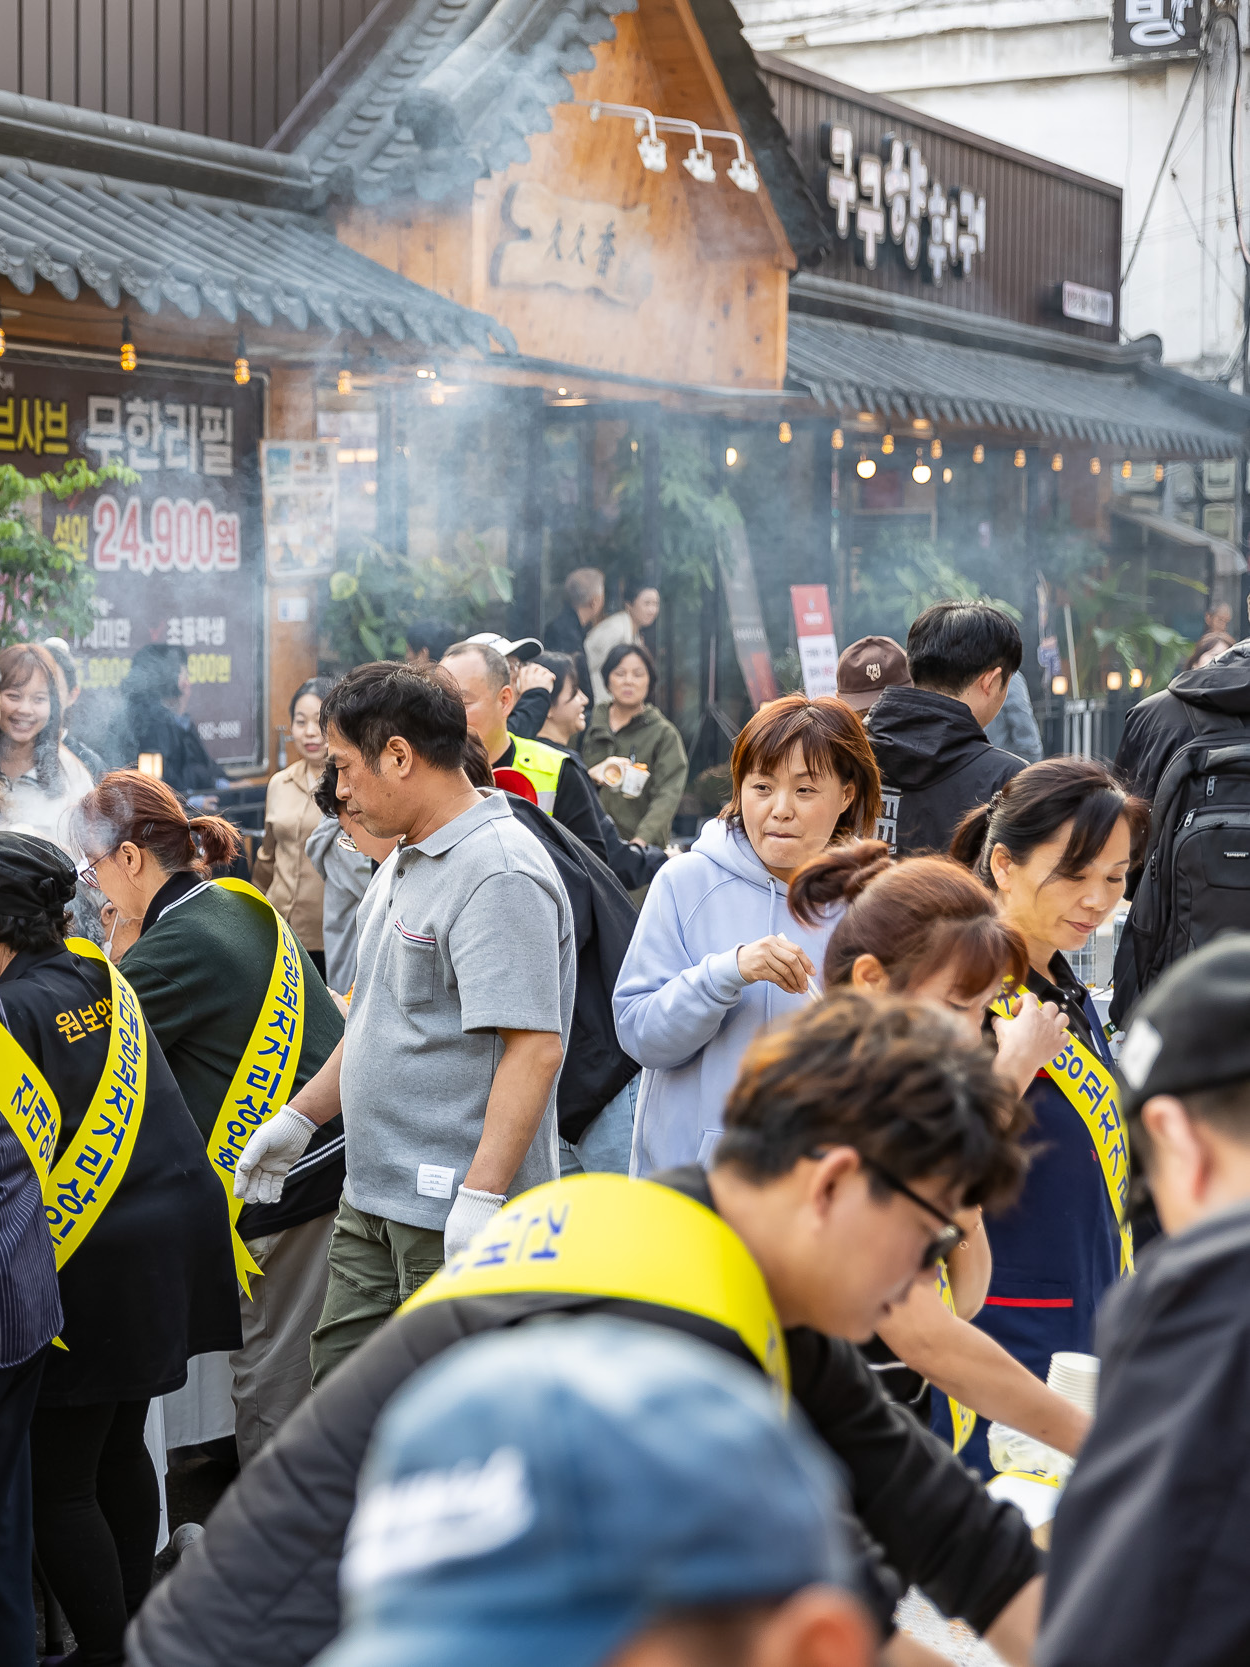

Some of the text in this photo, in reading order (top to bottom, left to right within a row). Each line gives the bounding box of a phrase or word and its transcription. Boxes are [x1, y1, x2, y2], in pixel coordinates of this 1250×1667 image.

[85, 395, 235, 476] 무한리필
[53, 514, 89, 561] 성인
[94, 495, 240, 575] 24,900원
[187, 653, 232, 685] 900원
[10, 1072, 57, 1175] 건대양
